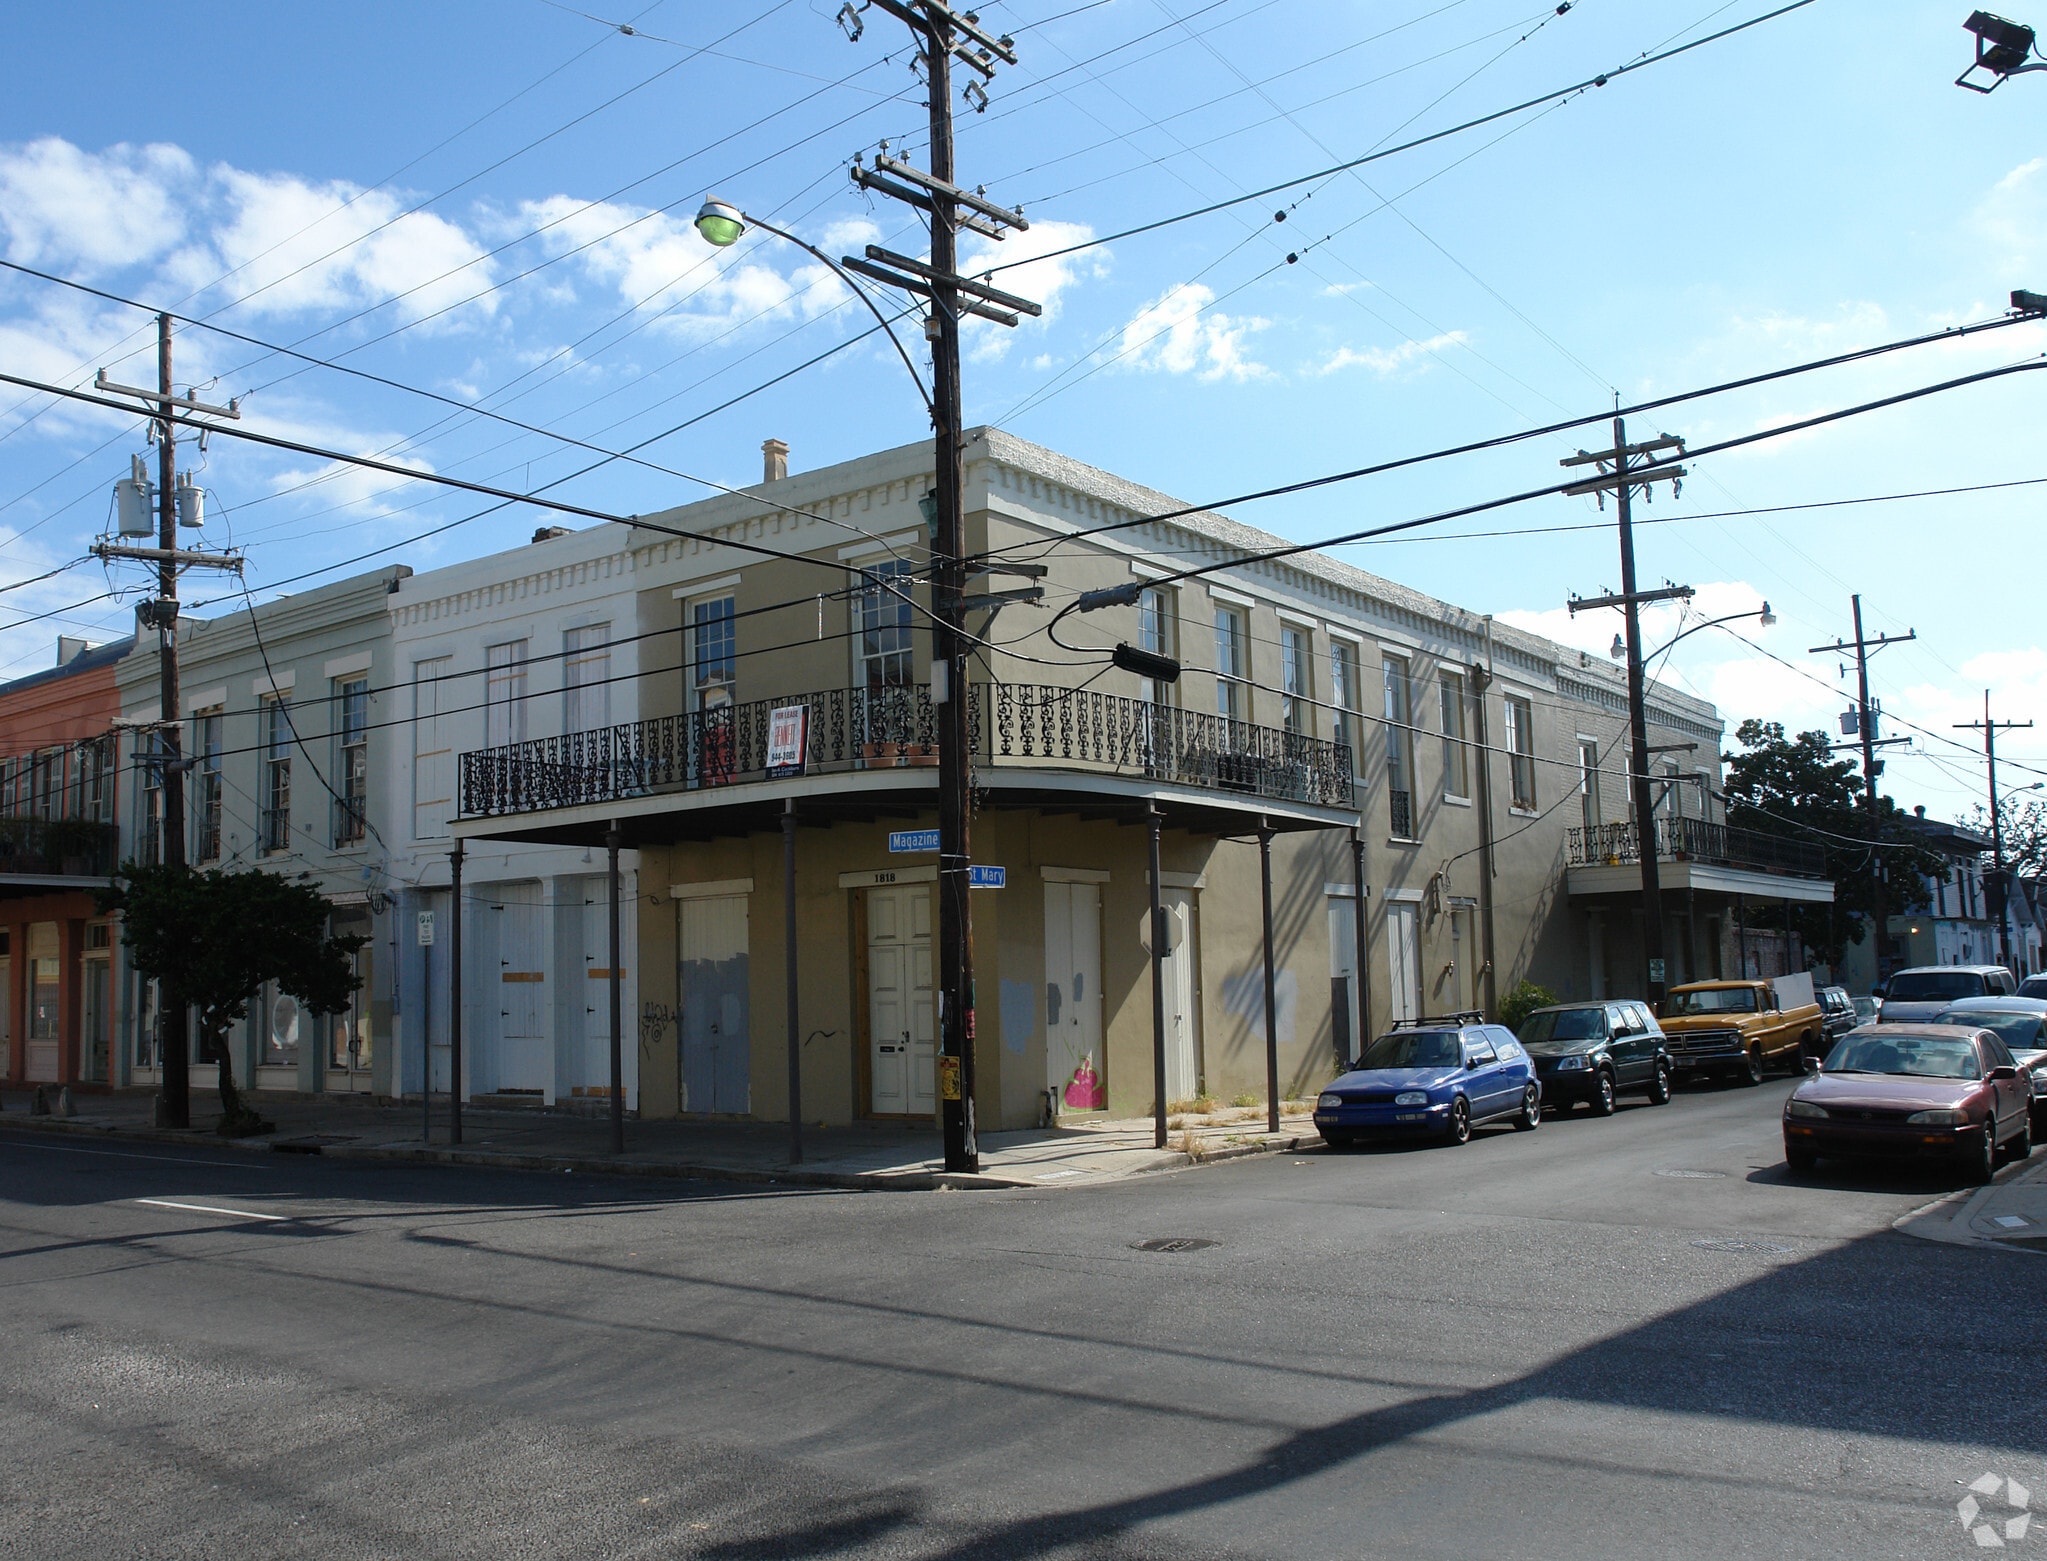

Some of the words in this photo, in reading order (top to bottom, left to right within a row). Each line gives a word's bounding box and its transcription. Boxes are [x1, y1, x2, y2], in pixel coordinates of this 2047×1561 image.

[776, 712, 784, 720] FOR
[785, 710, 798, 719] LEASE
[893, 832, 938, 850] Magazine
[875, 872, 896, 883] 1818
[969, 868, 977, 881] St
[981, 868, 1003, 884] Mary
